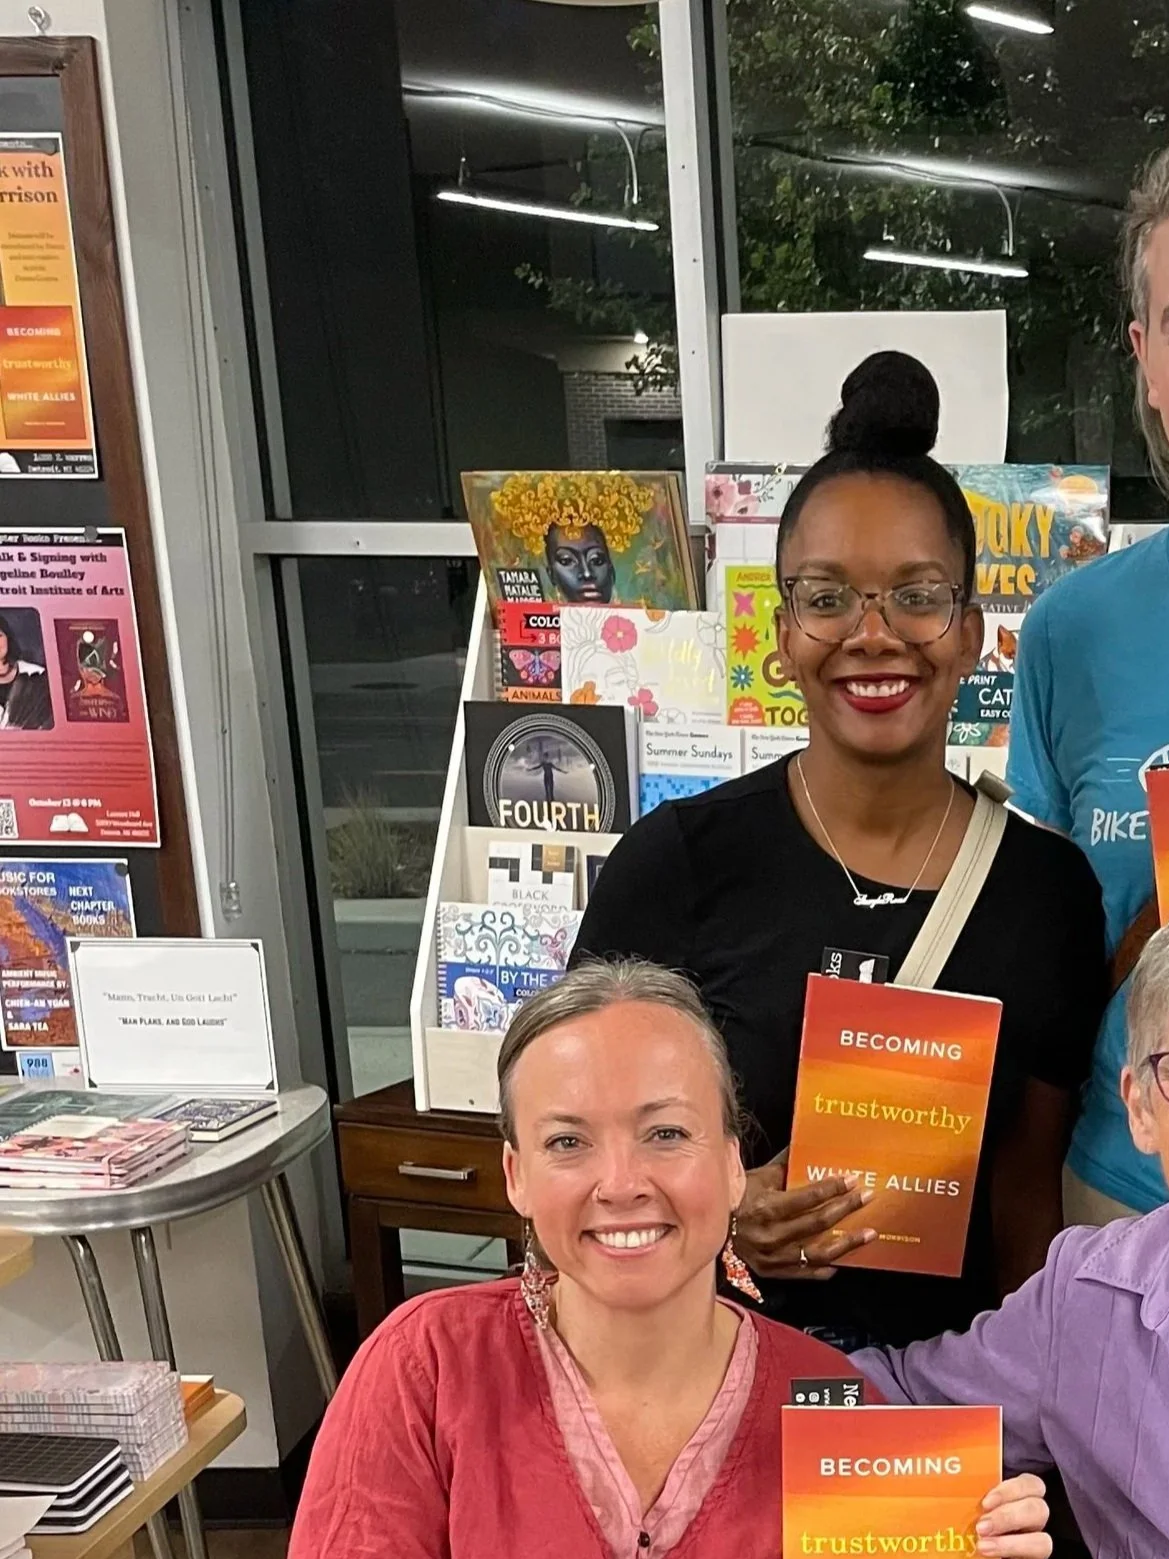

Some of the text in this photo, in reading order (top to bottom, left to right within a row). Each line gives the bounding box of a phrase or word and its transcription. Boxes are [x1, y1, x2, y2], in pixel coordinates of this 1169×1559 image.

[13, 160, 54, 178] with
[6, 327, 61, 337] BECOMING
[3, 356, 72, 371] trustworthy
[7, 392, 76, 401] WHITE ALLIES
[0, 552, 107, 565] lk & Signing with
[40, 568, 85, 581] Boulley
[499, 570, 538, 584] TAMARA
[31, 585, 82, 595] Institute
[86, 585, 97, 595] of
[101, 586, 124, 596] Arts
[504, 584, 541, 597] NATALIE
[538, 633, 546, 644] 3
[968, 675, 997, 686] PRINT
[512, 689, 562, 701] ANIMALS
[980, 709, 1002, 718] EASY
[646, 742, 733, 762] Summer Sundays
[499, 799, 600, 830] FOURTH
[1090, 807, 1150, 846] BIKE
[29, 872, 55, 883] FOR
[69, 886, 93, 897] NEXT
[512, 889, 549, 901] BLACK
[71, 900, 115, 911] CHAPTER
[73, 915, 105, 925] BOOKS
[501, 971, 518, 984] BY
[521, 972, 548, 988] THE
[840, 1030, 962, 1060] BECOMING
[27, 1058, 47, 1068] 988
[813, 1092, 973, 1135] trustworthy
[885, 1174, 960, 1197] ALLIES
[820, 1456, 962, 1476] BECOMING
[800, 1527, 979, 1558] trustworthy
